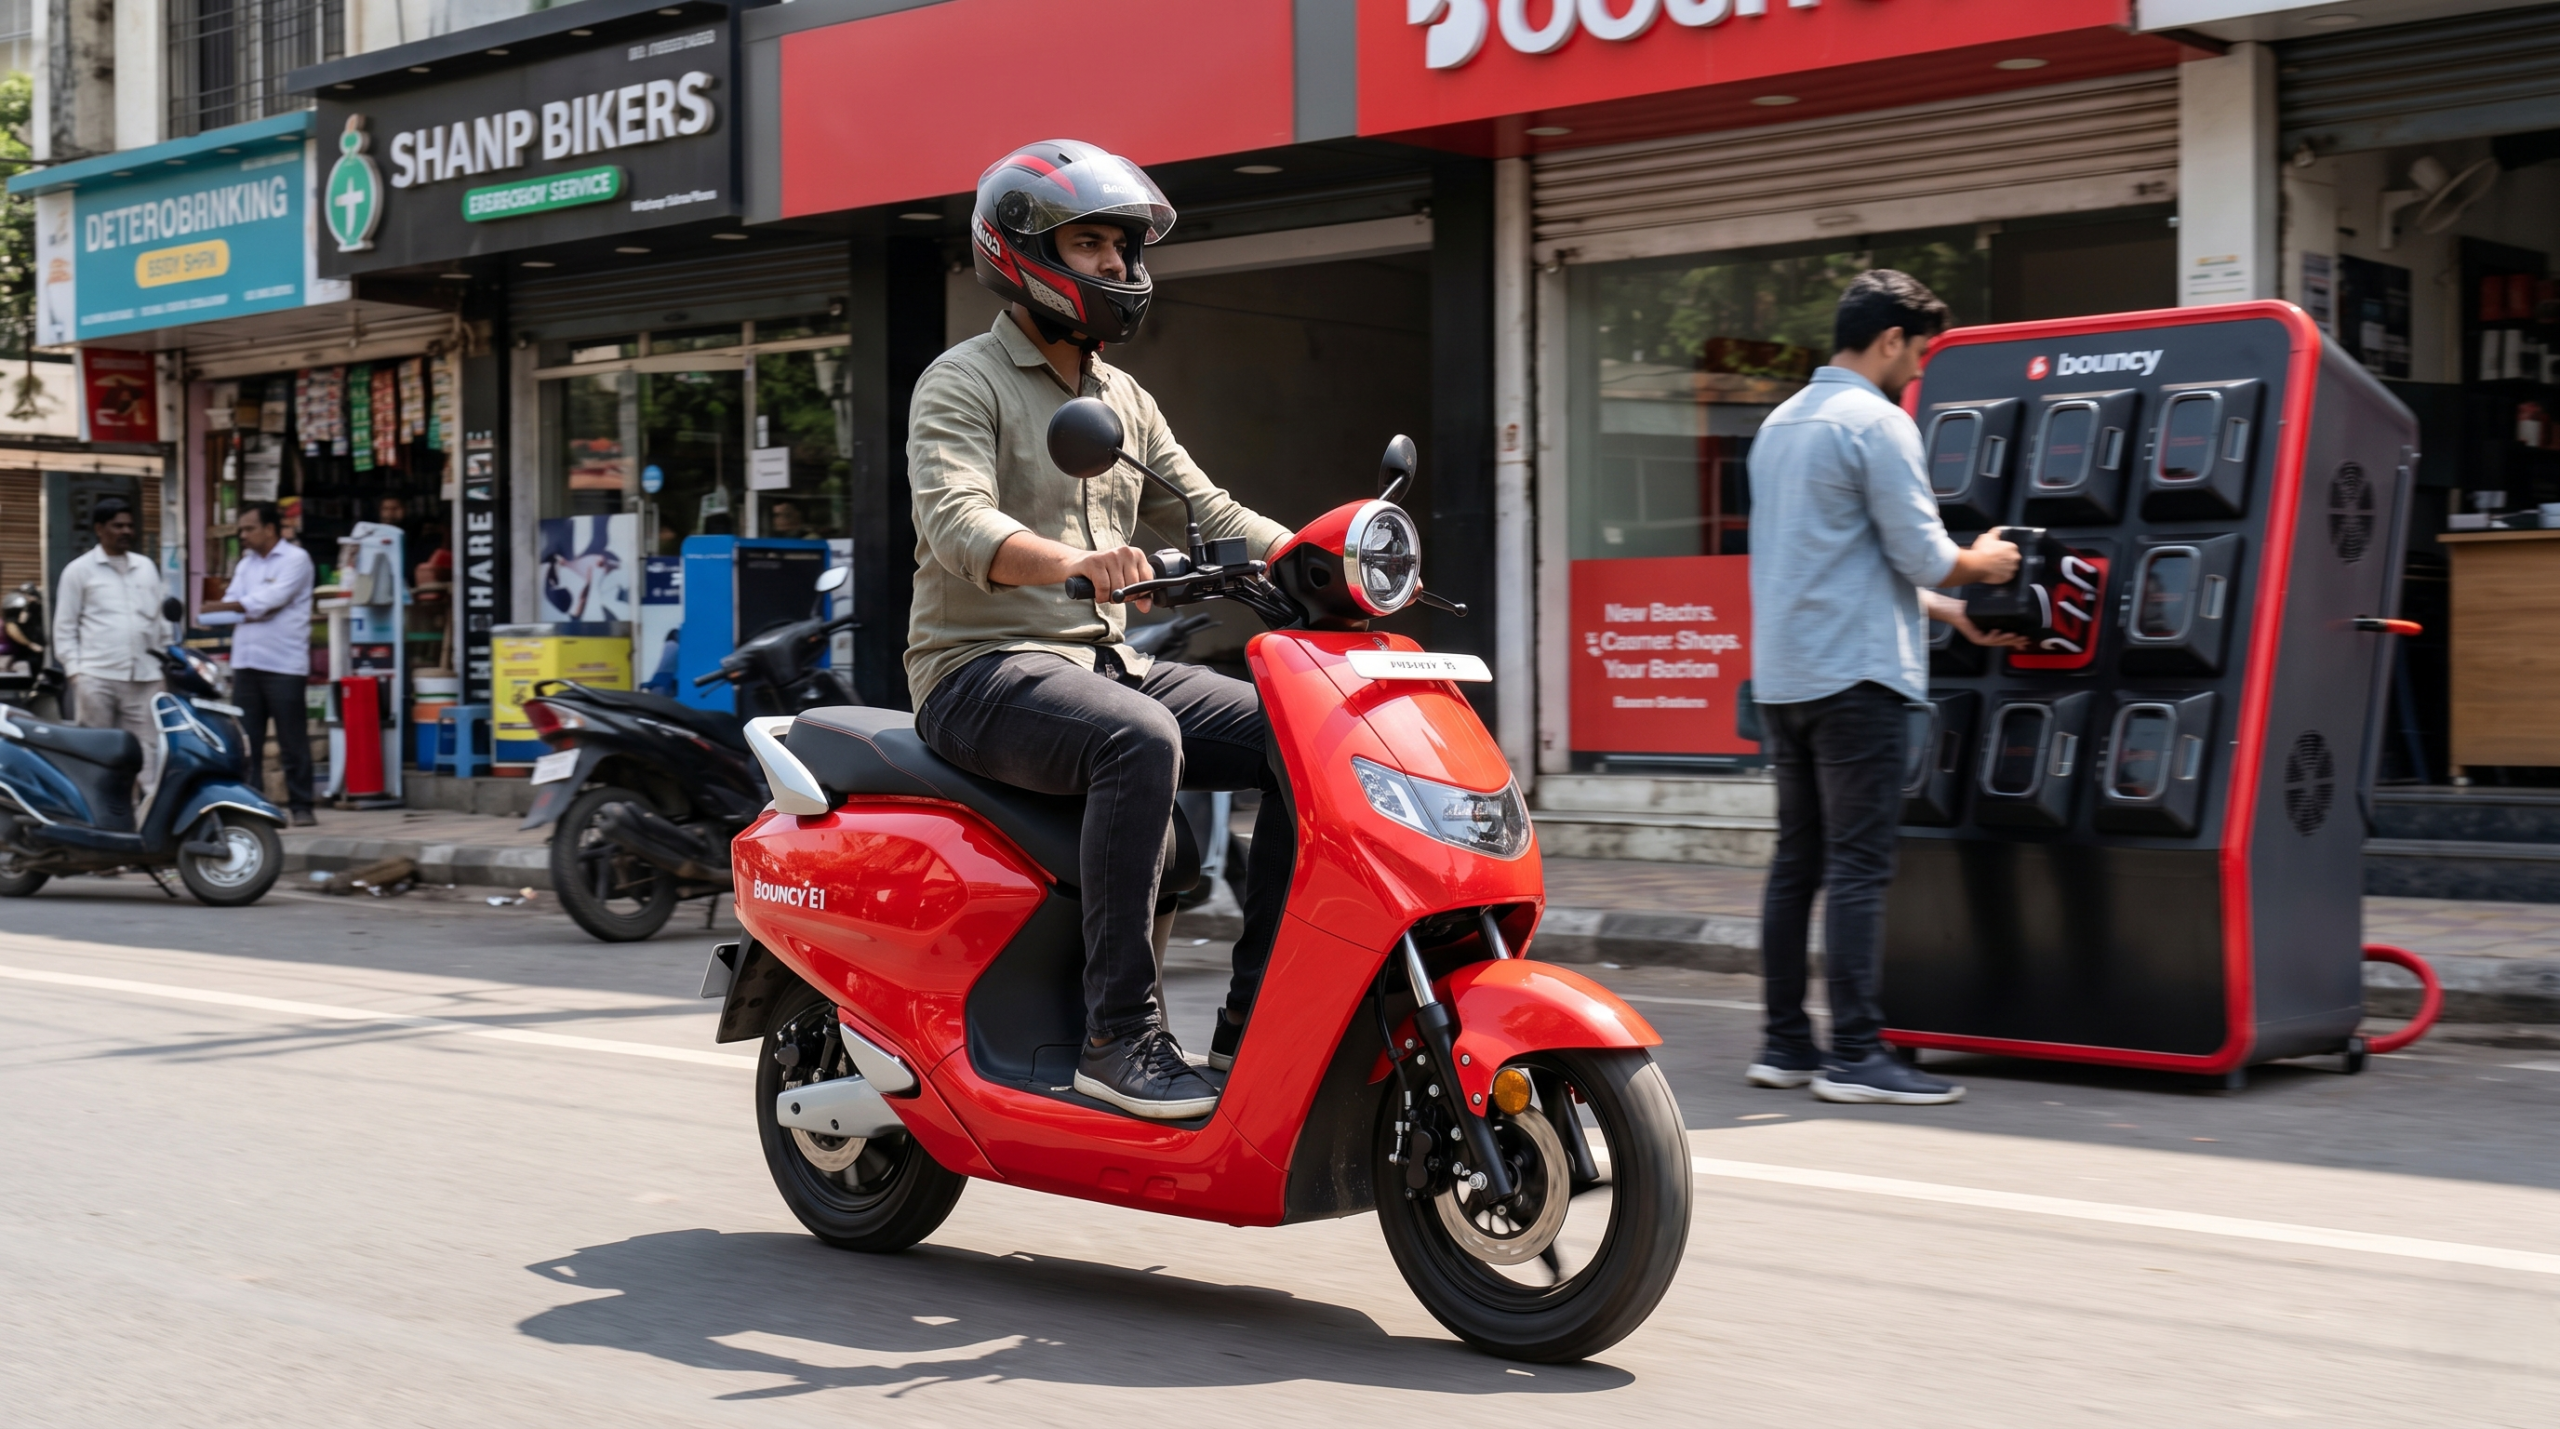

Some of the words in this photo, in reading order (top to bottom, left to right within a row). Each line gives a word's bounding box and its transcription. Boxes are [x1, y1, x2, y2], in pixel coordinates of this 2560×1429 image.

[391, 109, 537, 189] SHANP
[542, 71, 717, 161] BIKERS
[549, 172, 612, 201] SERVICE
[2056, 349, 2165, 377] bouncy
[1604, 603, 1648, 623] New
[1675, 630, 1742, 655] Shops.
[1602, 659, 1647, 679] Your
[753, 879, 808, 907] BOUNCY
[809, 887, 825, 910] E1
